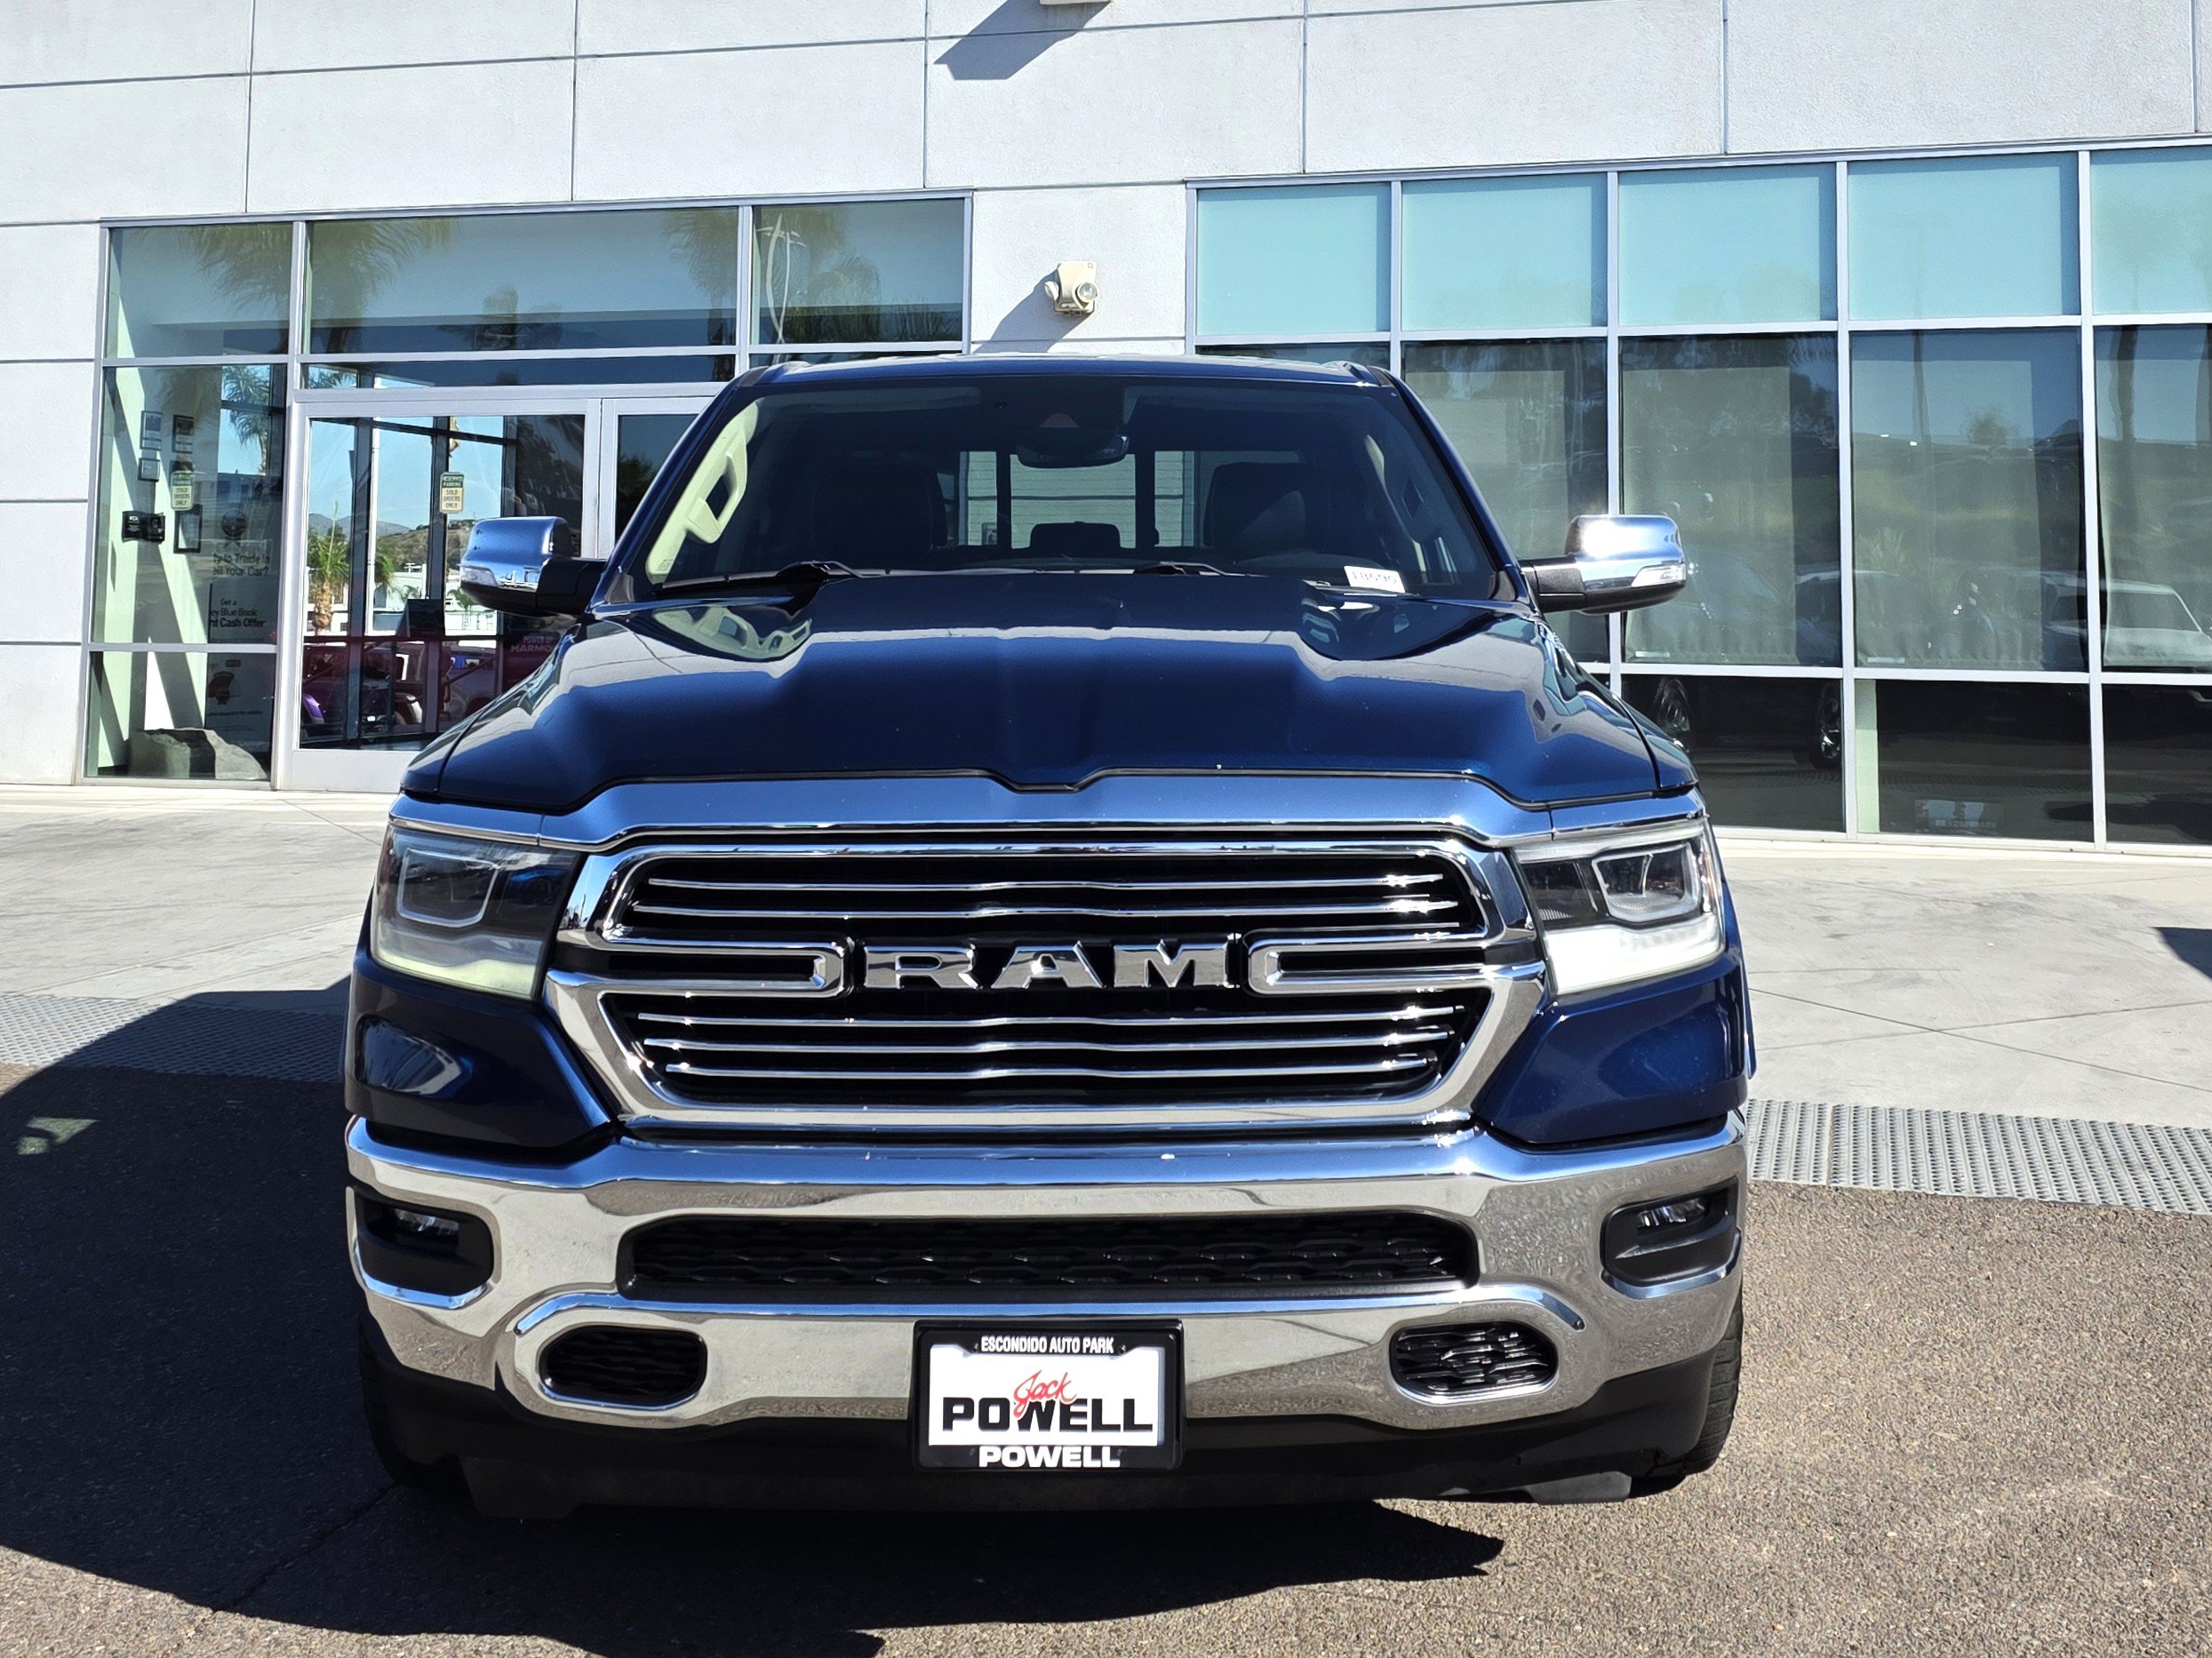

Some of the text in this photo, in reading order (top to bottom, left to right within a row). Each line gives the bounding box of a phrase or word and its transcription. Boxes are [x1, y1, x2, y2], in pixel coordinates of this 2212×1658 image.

[235, 553, 260, 564] Trade
[225, 566, 244, 576] Your
[247, 566, 269, 577] Car?
[220, 608, 237, 617] Blue
[238, 608, 257, 617] Book
[220, 617, 242, 627] Cash
[243, 617, 266, 627] Offer
[864, 940, 1230, 989] RAM
[981, 1336, 1114, 1354] ESCONDIDO AUTO PARK
[1013, 1369, 1077, 1419] Jack
[942, 1397, 1154, 1432] POWELL
[978, 1446, 1121, 1468] POWELL
